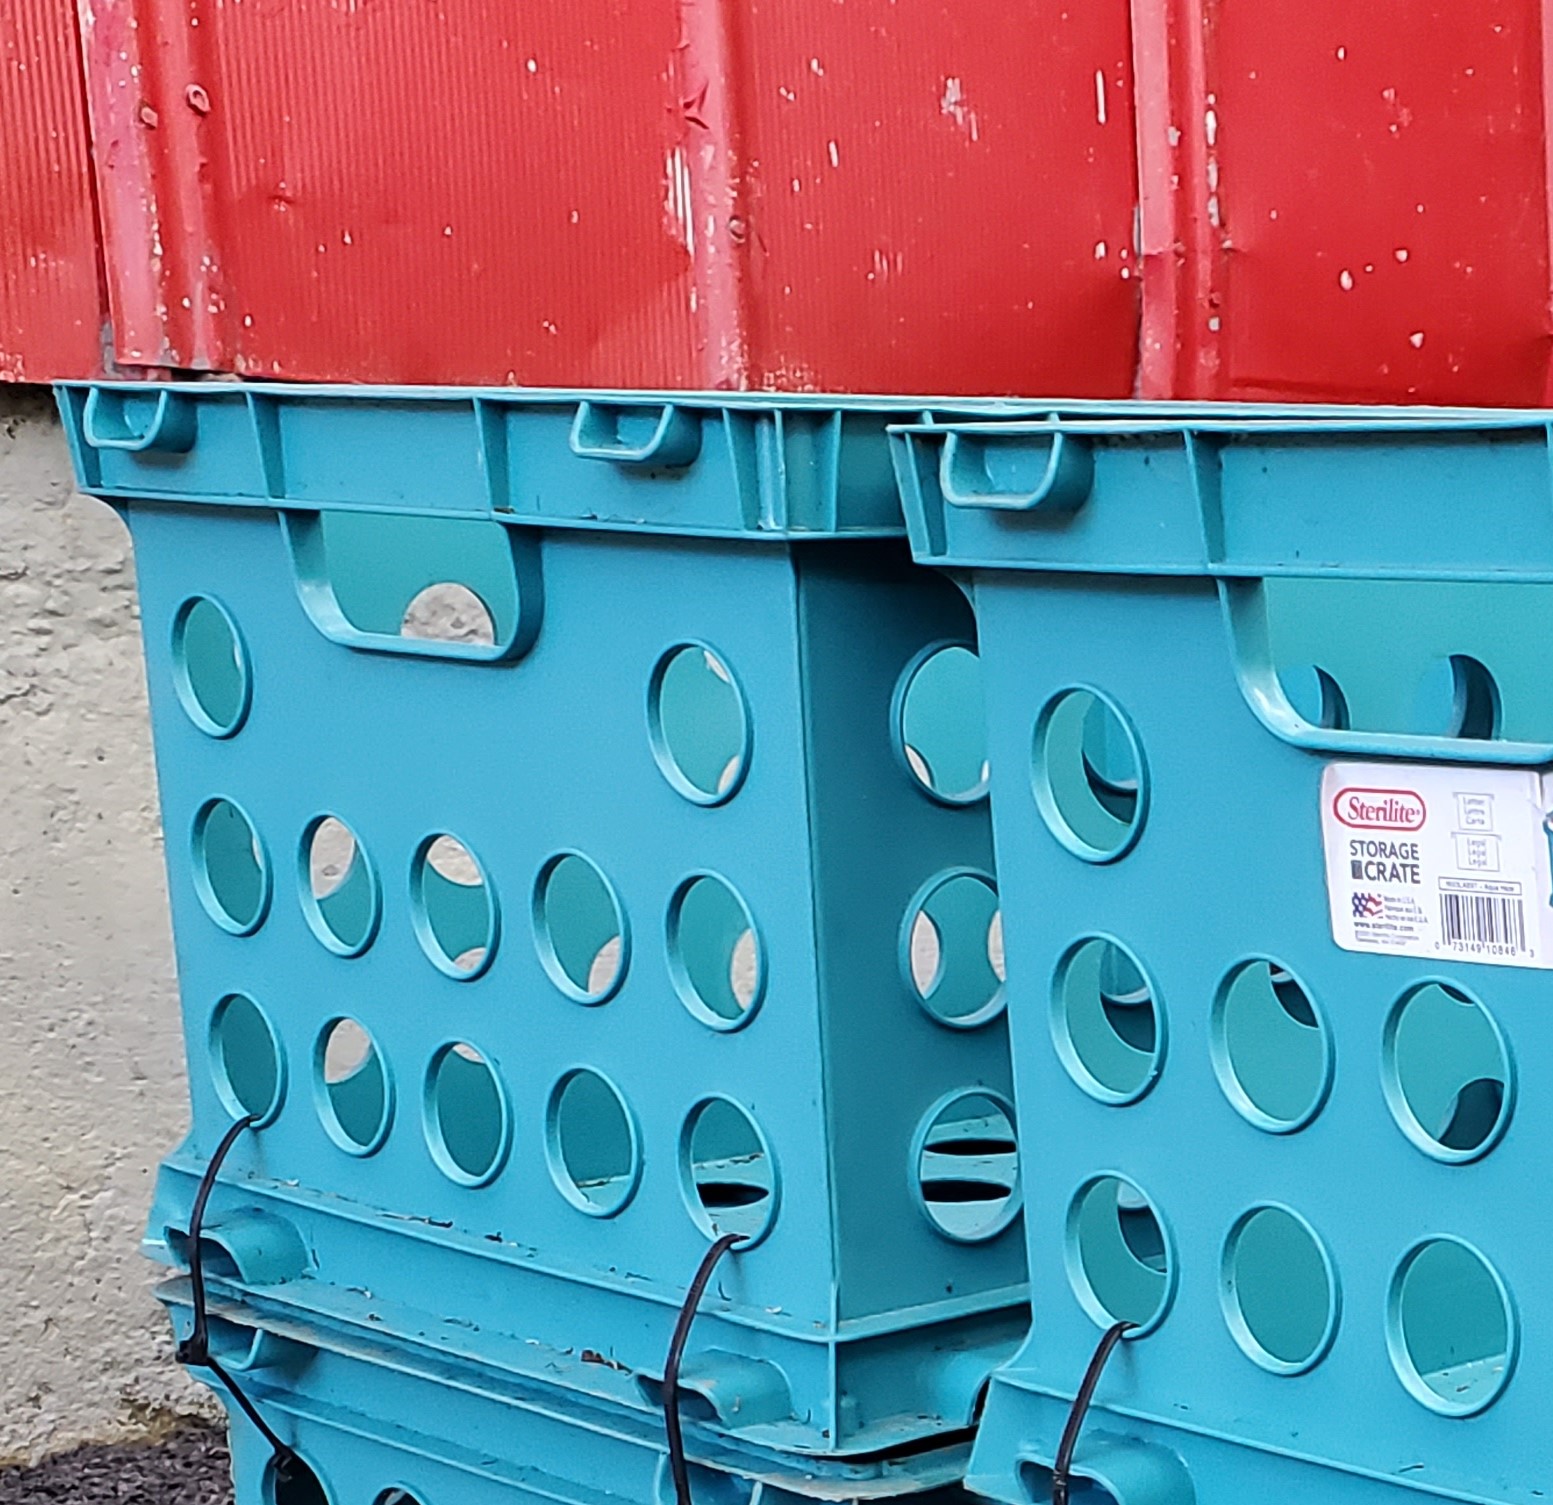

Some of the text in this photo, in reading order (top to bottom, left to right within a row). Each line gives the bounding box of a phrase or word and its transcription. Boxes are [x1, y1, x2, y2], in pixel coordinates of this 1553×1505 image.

[1347, 796, 1416, 824] Sterilite
[1350, 839, 1420, 861] STORAGE
[1364, 861, 1421, 885] CRATE
